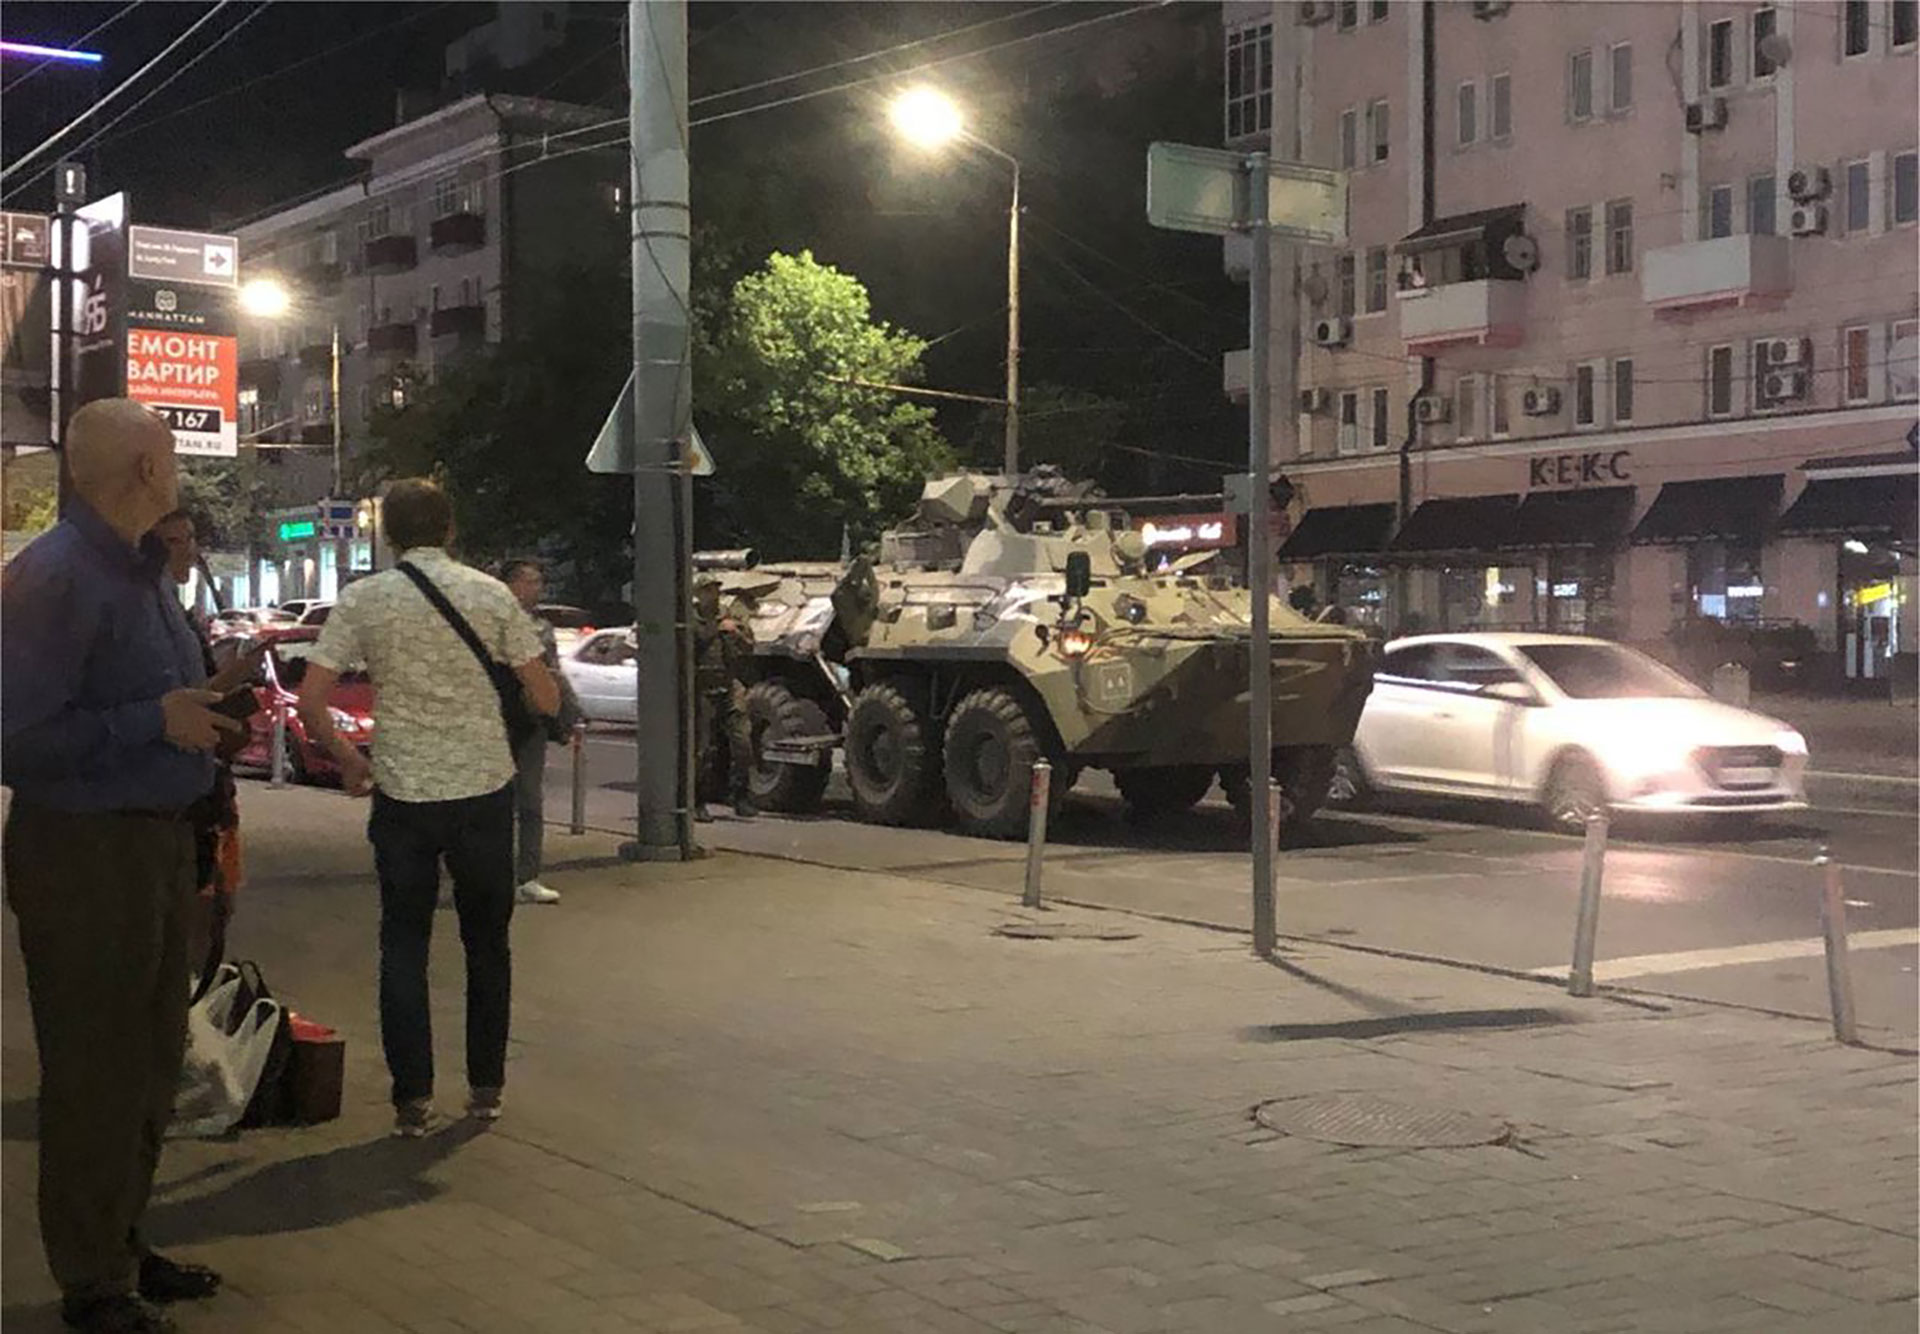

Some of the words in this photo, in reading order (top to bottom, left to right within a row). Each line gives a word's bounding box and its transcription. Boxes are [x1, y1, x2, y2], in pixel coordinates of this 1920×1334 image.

[128, 333, 219, 360] ЕМОНТ
[128, 359, 219, 385] ВАРТИР
[176, 411, 208, 428] 167
